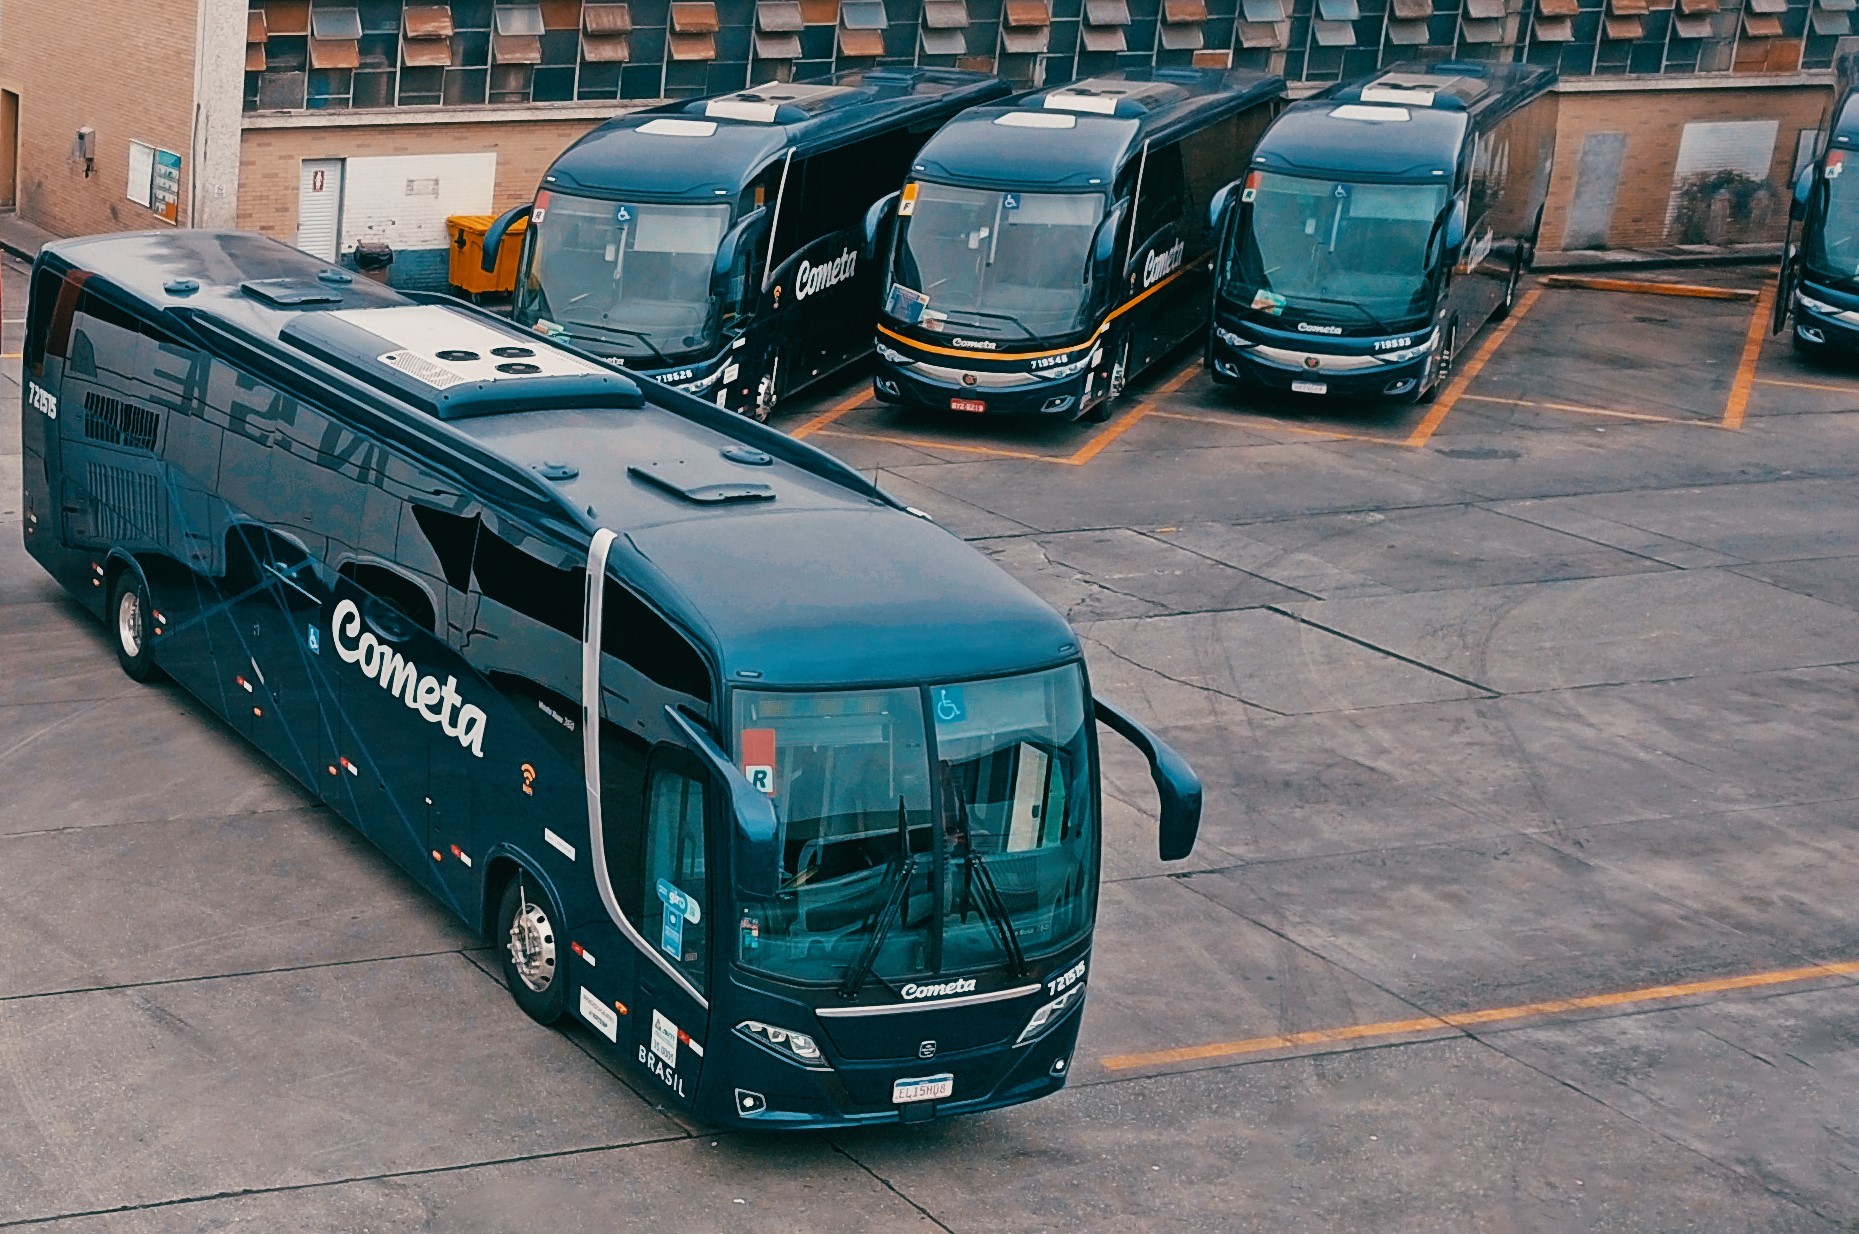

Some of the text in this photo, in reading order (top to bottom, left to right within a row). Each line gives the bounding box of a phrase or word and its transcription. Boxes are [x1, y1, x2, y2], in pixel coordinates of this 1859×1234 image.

[795, 246, 858, 301] Cometa
[1143, 237, 1185, 288] Cometa
[952, 338, 997, 350] Cometa
[1297, 322, 1343, 335] Cometa
[331, 599, 488, 758] Cometa
[753, 769, 768, 789] R
[900, 979, 977, 1000] Cometa
[1047, 960, 1086, 996] 721515
[638, 1044, 686, 1098] BRASIL
